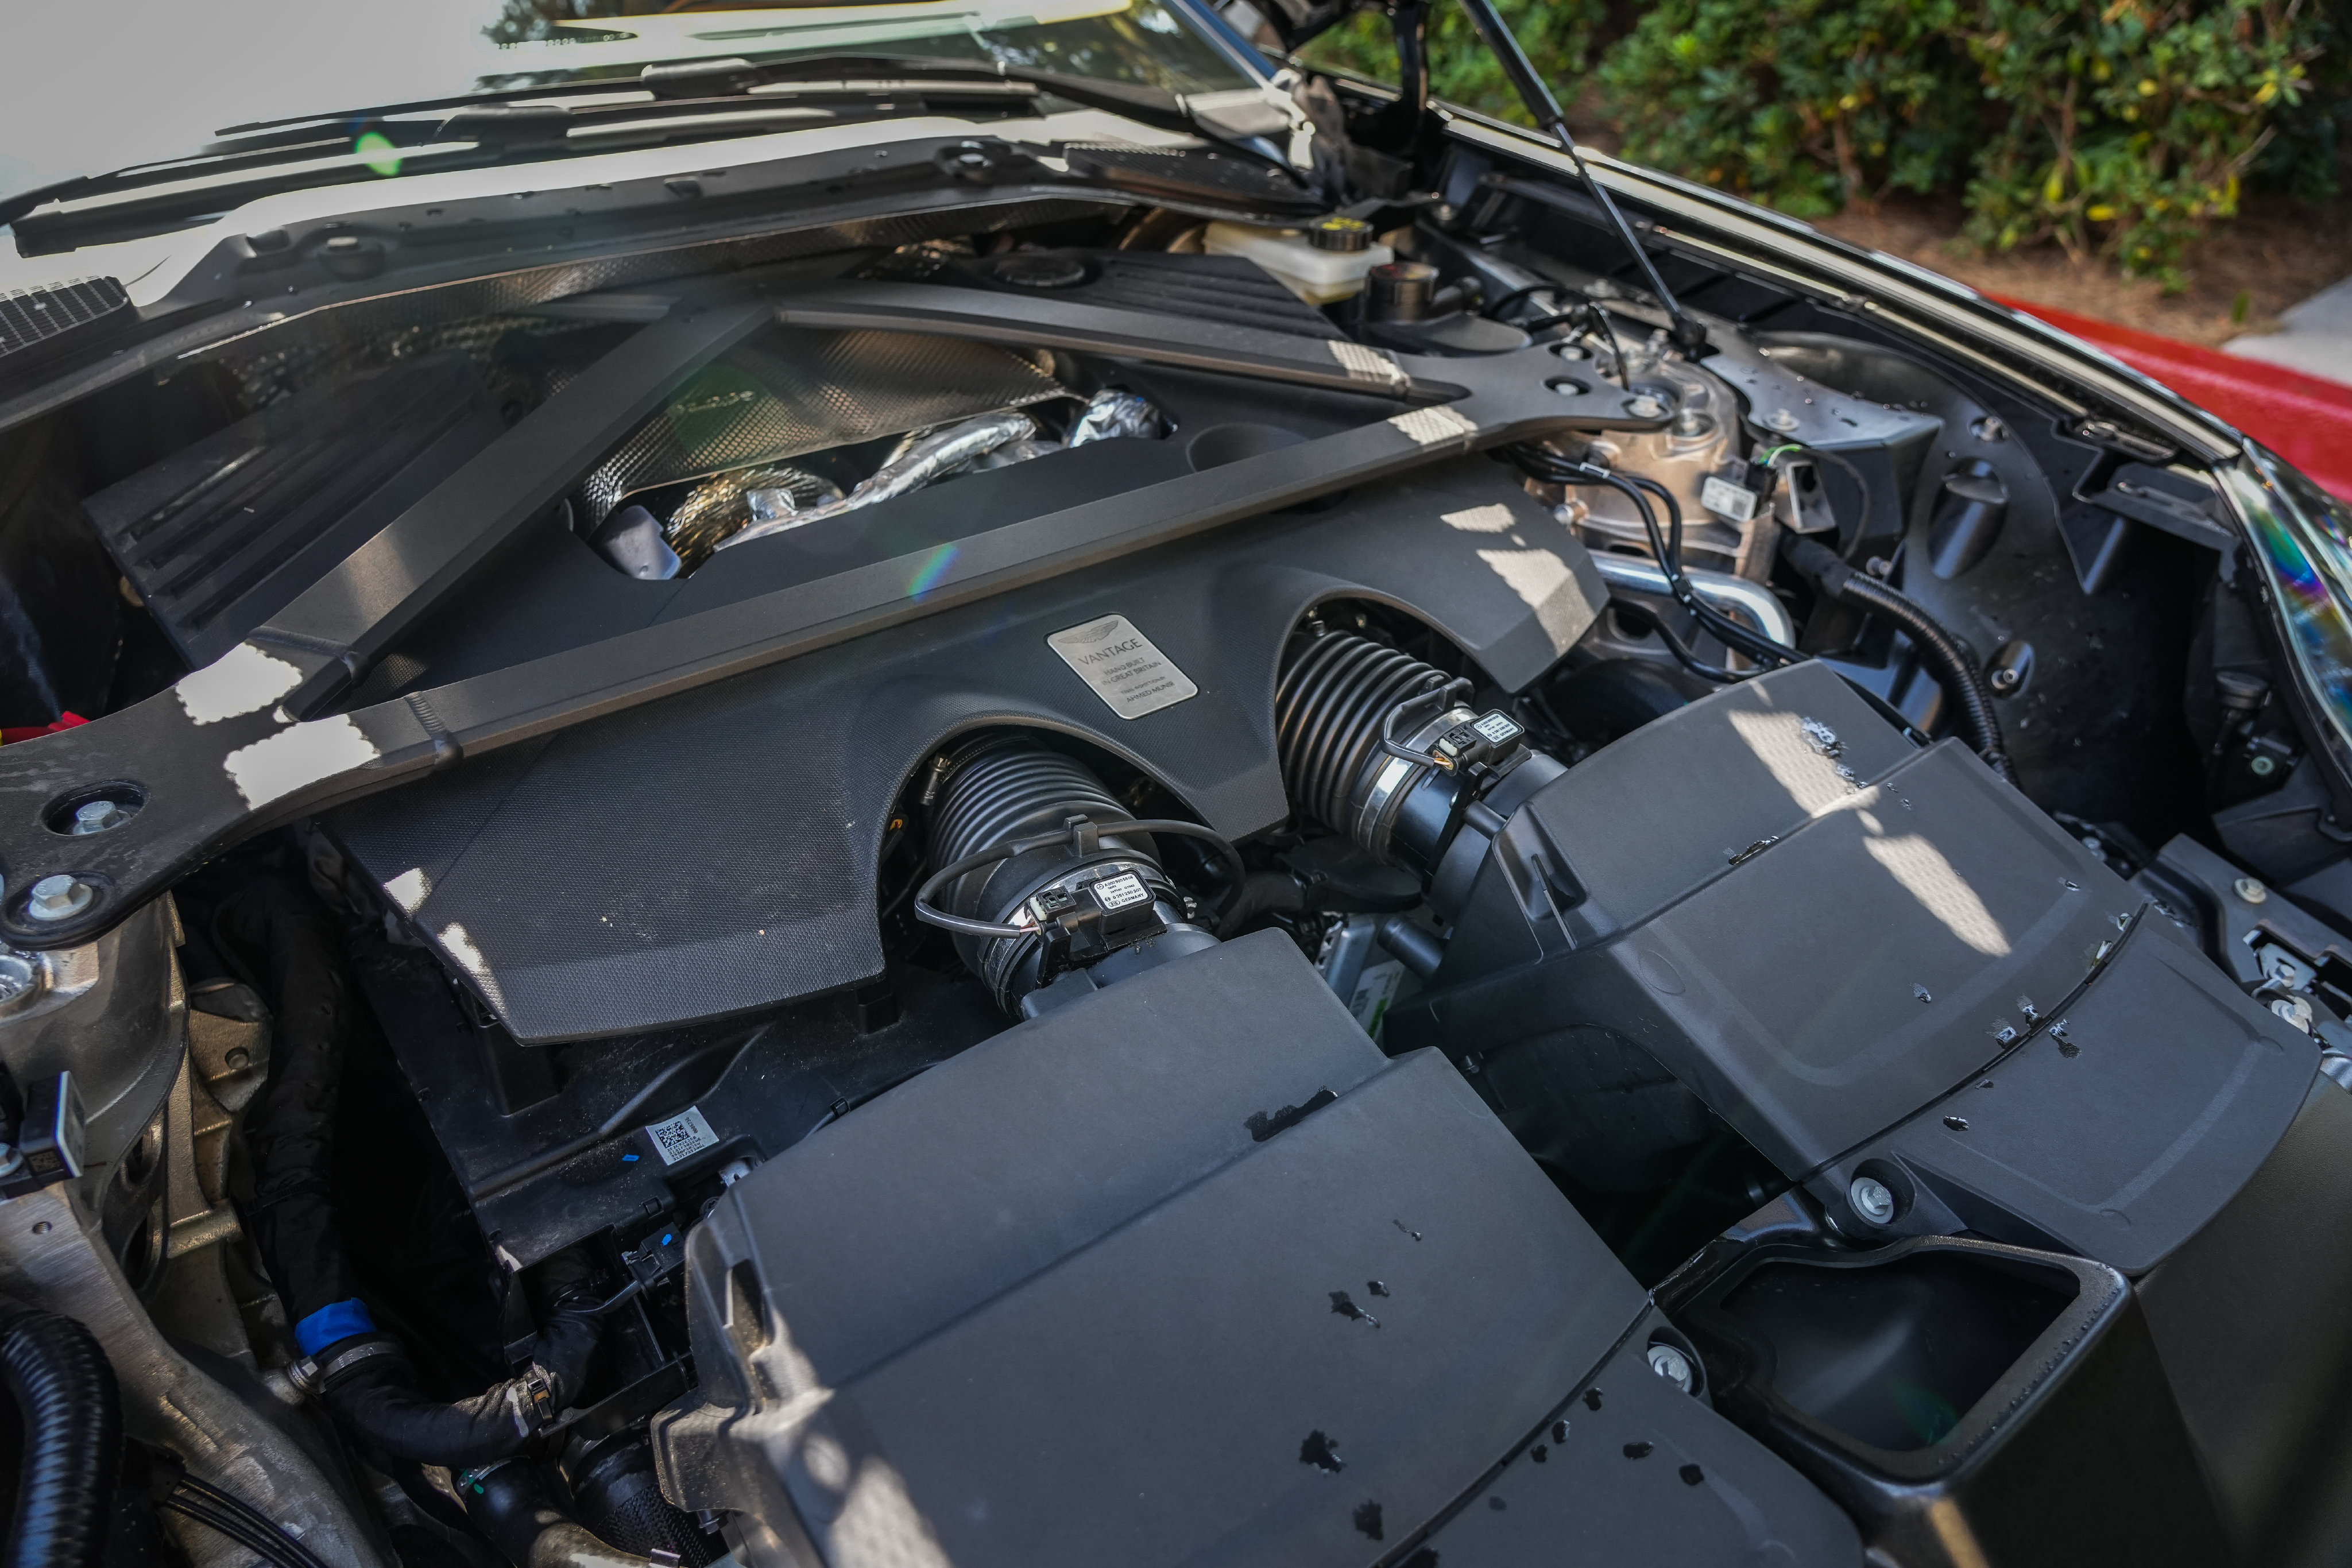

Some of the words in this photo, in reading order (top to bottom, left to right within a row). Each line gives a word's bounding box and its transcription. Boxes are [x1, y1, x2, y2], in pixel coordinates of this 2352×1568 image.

[1078, 638, 1143, 665] VANTAGE
[1104, 665, 1126, 676] HAND
[1125, 657, 1145, 668] BUILT
[1111, 670, 1134, 683] GREAT
[1133, 661, 1162, 674] BRITAIN
[1127, 690, 1152, 703] AHMED
[1121, 893, 1144, 903] GERMANY
